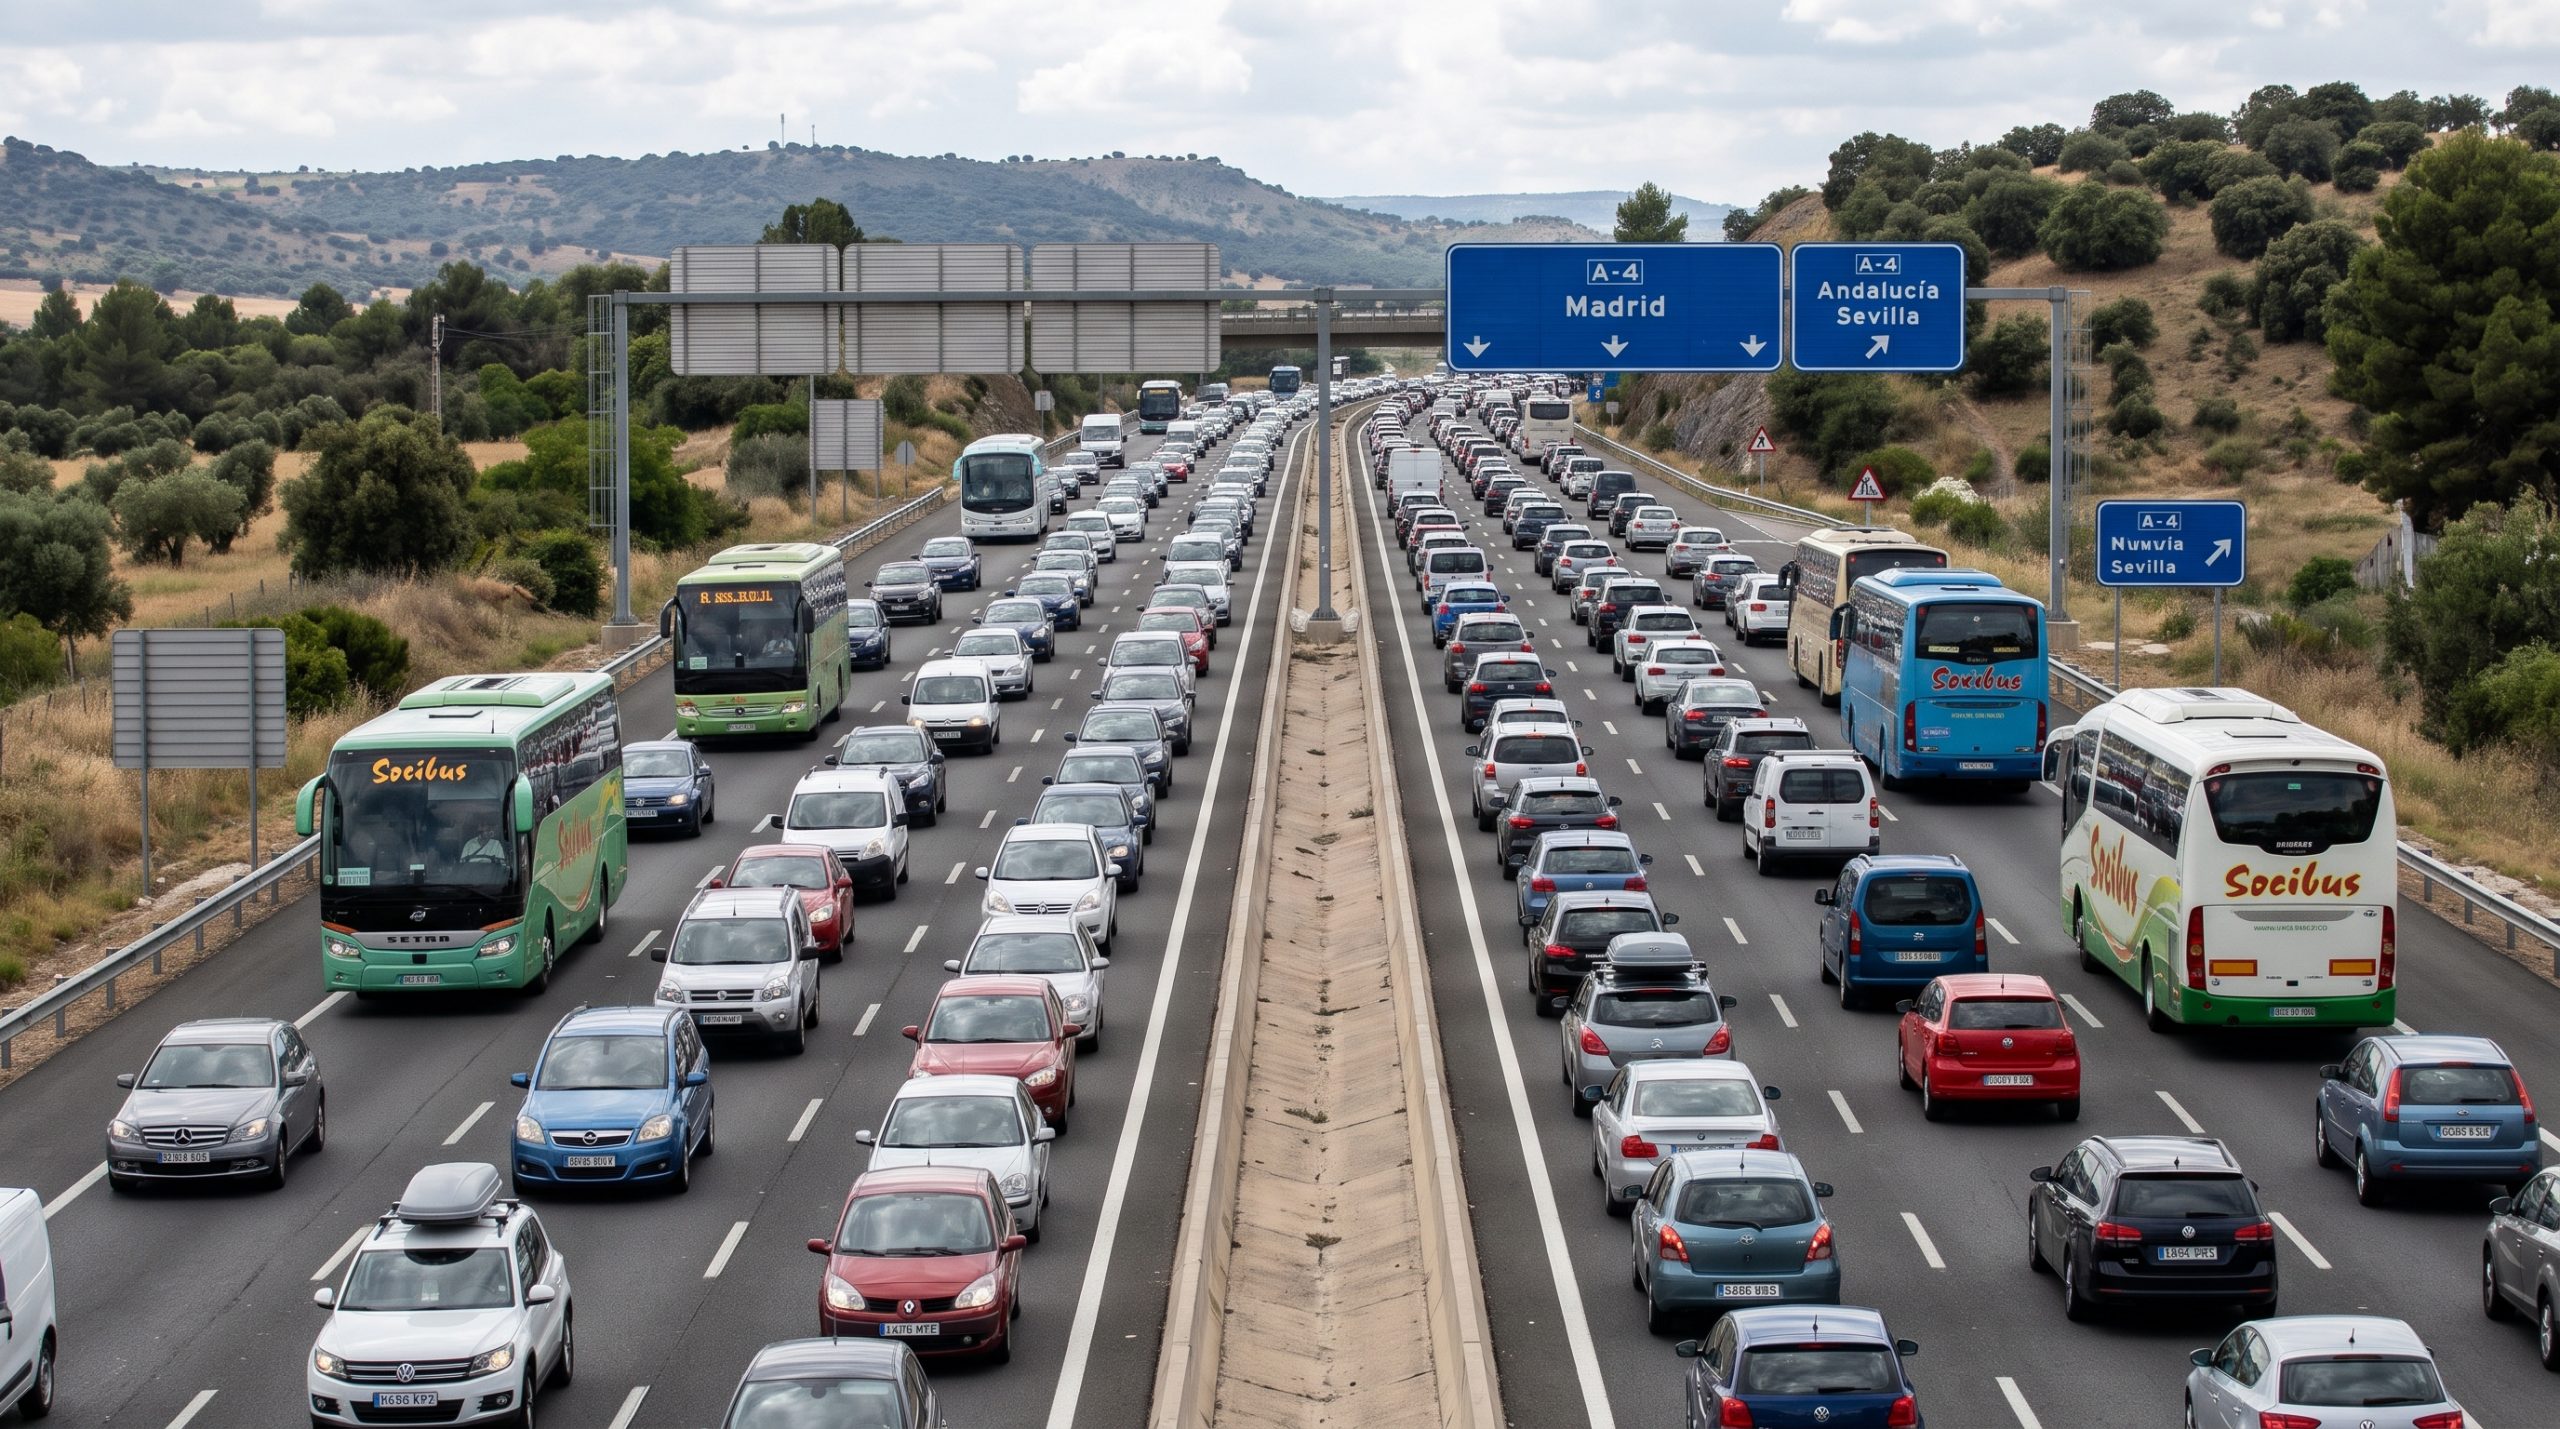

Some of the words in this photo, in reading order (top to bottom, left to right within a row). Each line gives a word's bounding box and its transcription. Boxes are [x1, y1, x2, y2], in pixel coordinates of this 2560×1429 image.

[1592, 264, 1638, 281] A-4
[1860, 257, 1897, 271] A-4
[1818, 281, 1938, 299] Andalucía
[1566, 295, 1665, 317] Madrid
[1837, 307, 1919, 325] Sevilla
[2142, 515, 2178, 528] A-4
[2111, 560, 2176, 573] Sevilla
[372, 756, 467, 784] Socibus
[2225, 860, 2362, 898] Socibus
